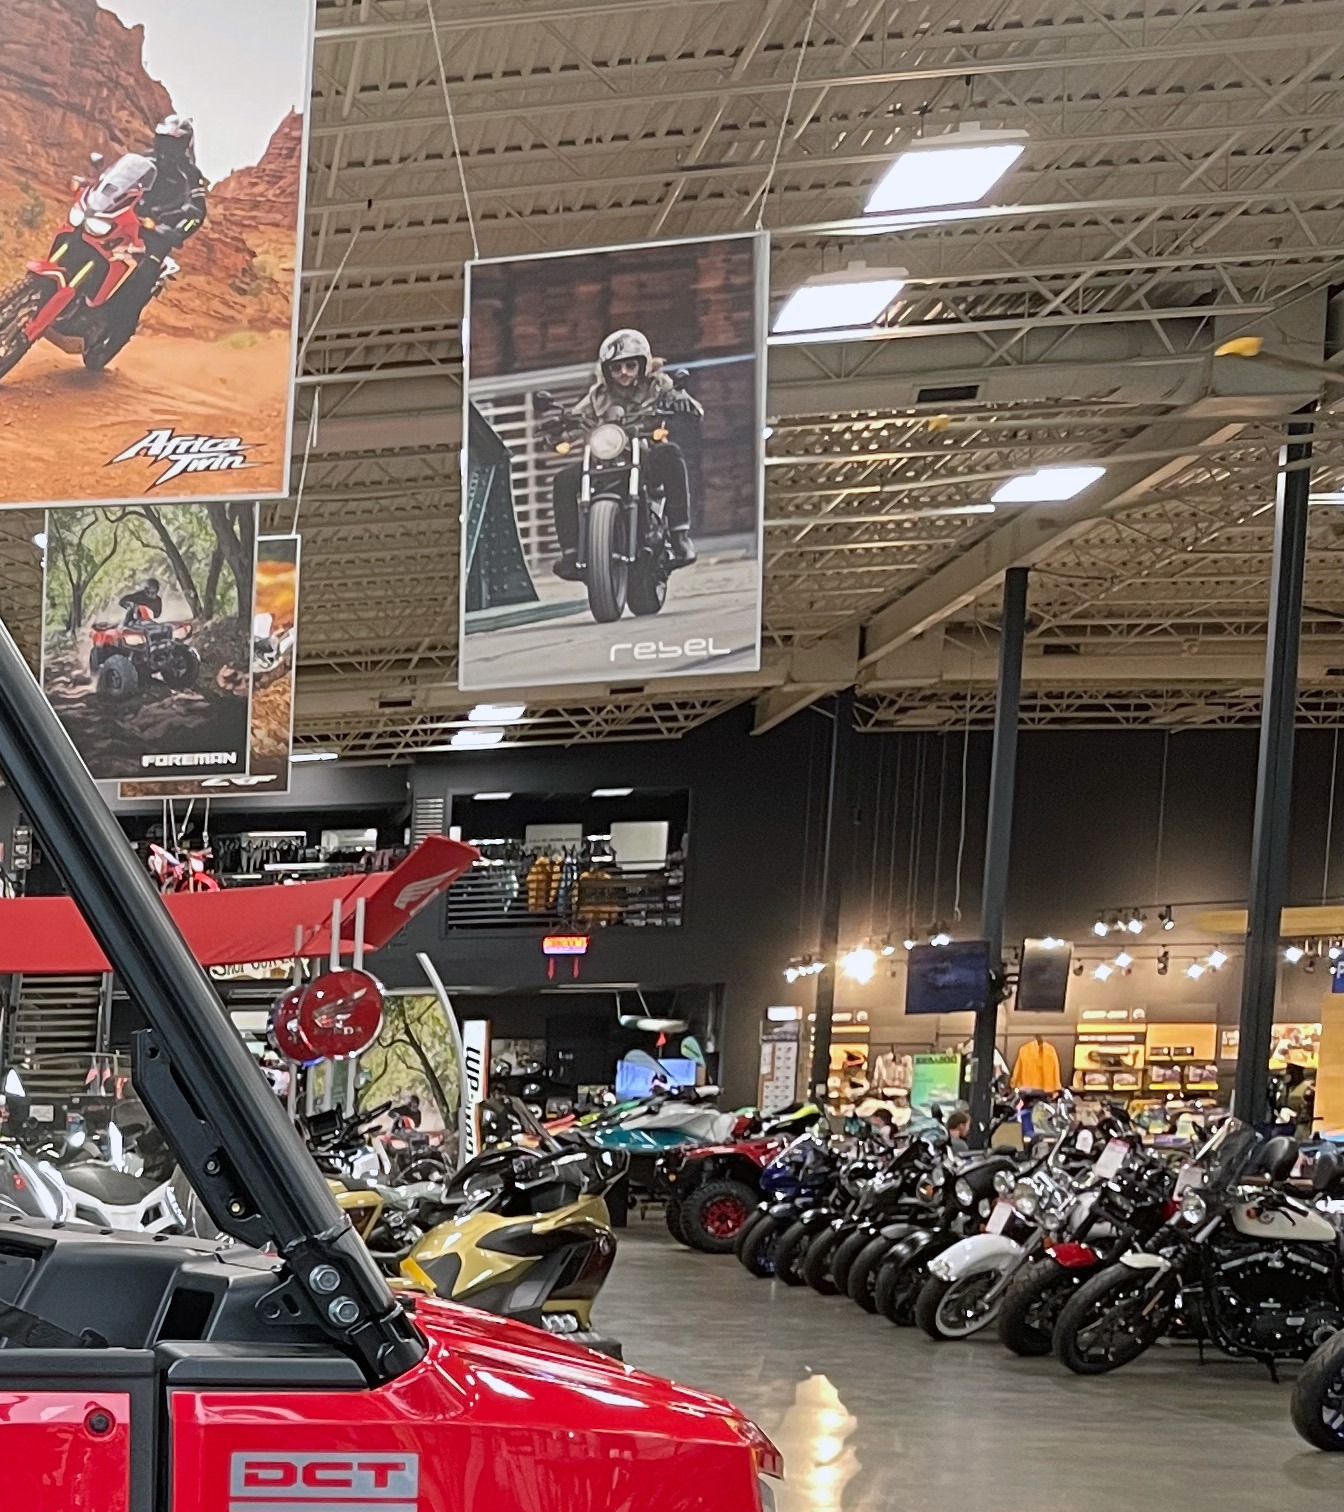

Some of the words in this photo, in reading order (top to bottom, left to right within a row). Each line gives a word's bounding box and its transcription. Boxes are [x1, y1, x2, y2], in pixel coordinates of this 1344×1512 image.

[104, 427, 266, 467] Africa
[144, 452, 272, 494] Twin
[141, 751, 238, 769] FOREMAN
[244, 1461, 406, 1489] DCT
